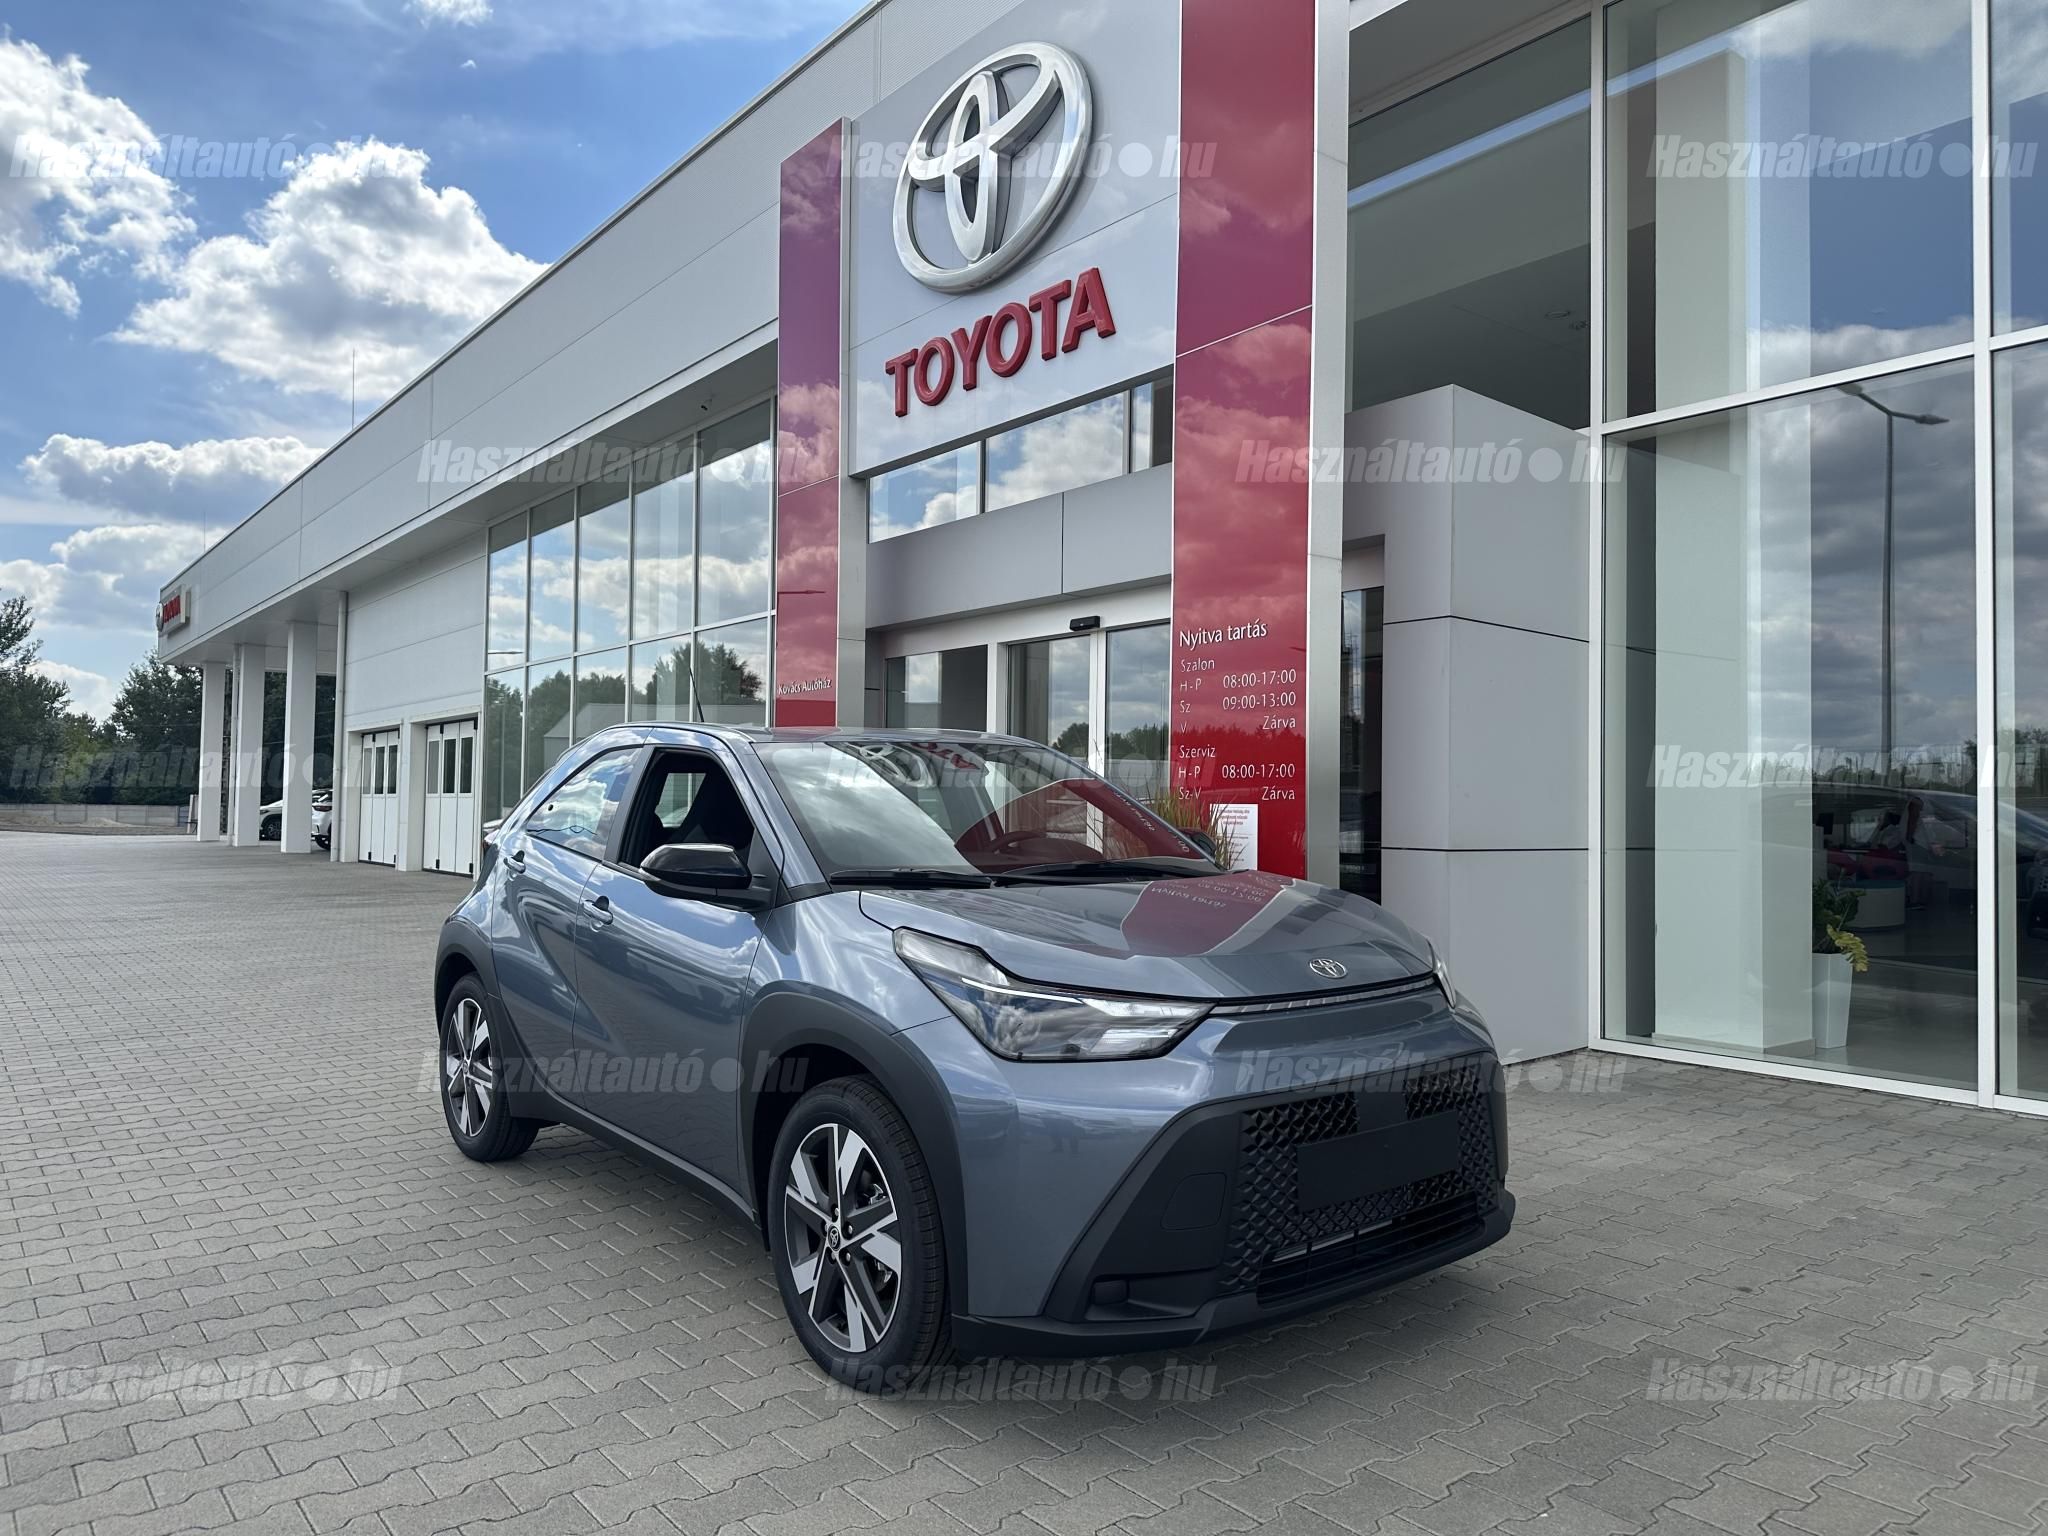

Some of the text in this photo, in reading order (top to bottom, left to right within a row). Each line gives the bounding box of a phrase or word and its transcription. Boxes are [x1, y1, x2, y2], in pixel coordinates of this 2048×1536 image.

[885, 267, 1116, 417] TOYOTA
[1179, 618, 1268, 651] Nyitva tartás
[1181, 658, 1215, 672] Szalon
[778, 676, 831, 695] Kovács Autóház
[1222, 668, 1297, 689] 08:00-17:00
[1179, 691, 1297, 713] Sz 09:00-13:00
[1180, 714, 1297, 734] V Zárva
[1179, 744, 1216, 759] Szerviz
[1221, 763, 1296, 779] 08:00-17:00
[1261, 785, 1296, 801] Zárva
